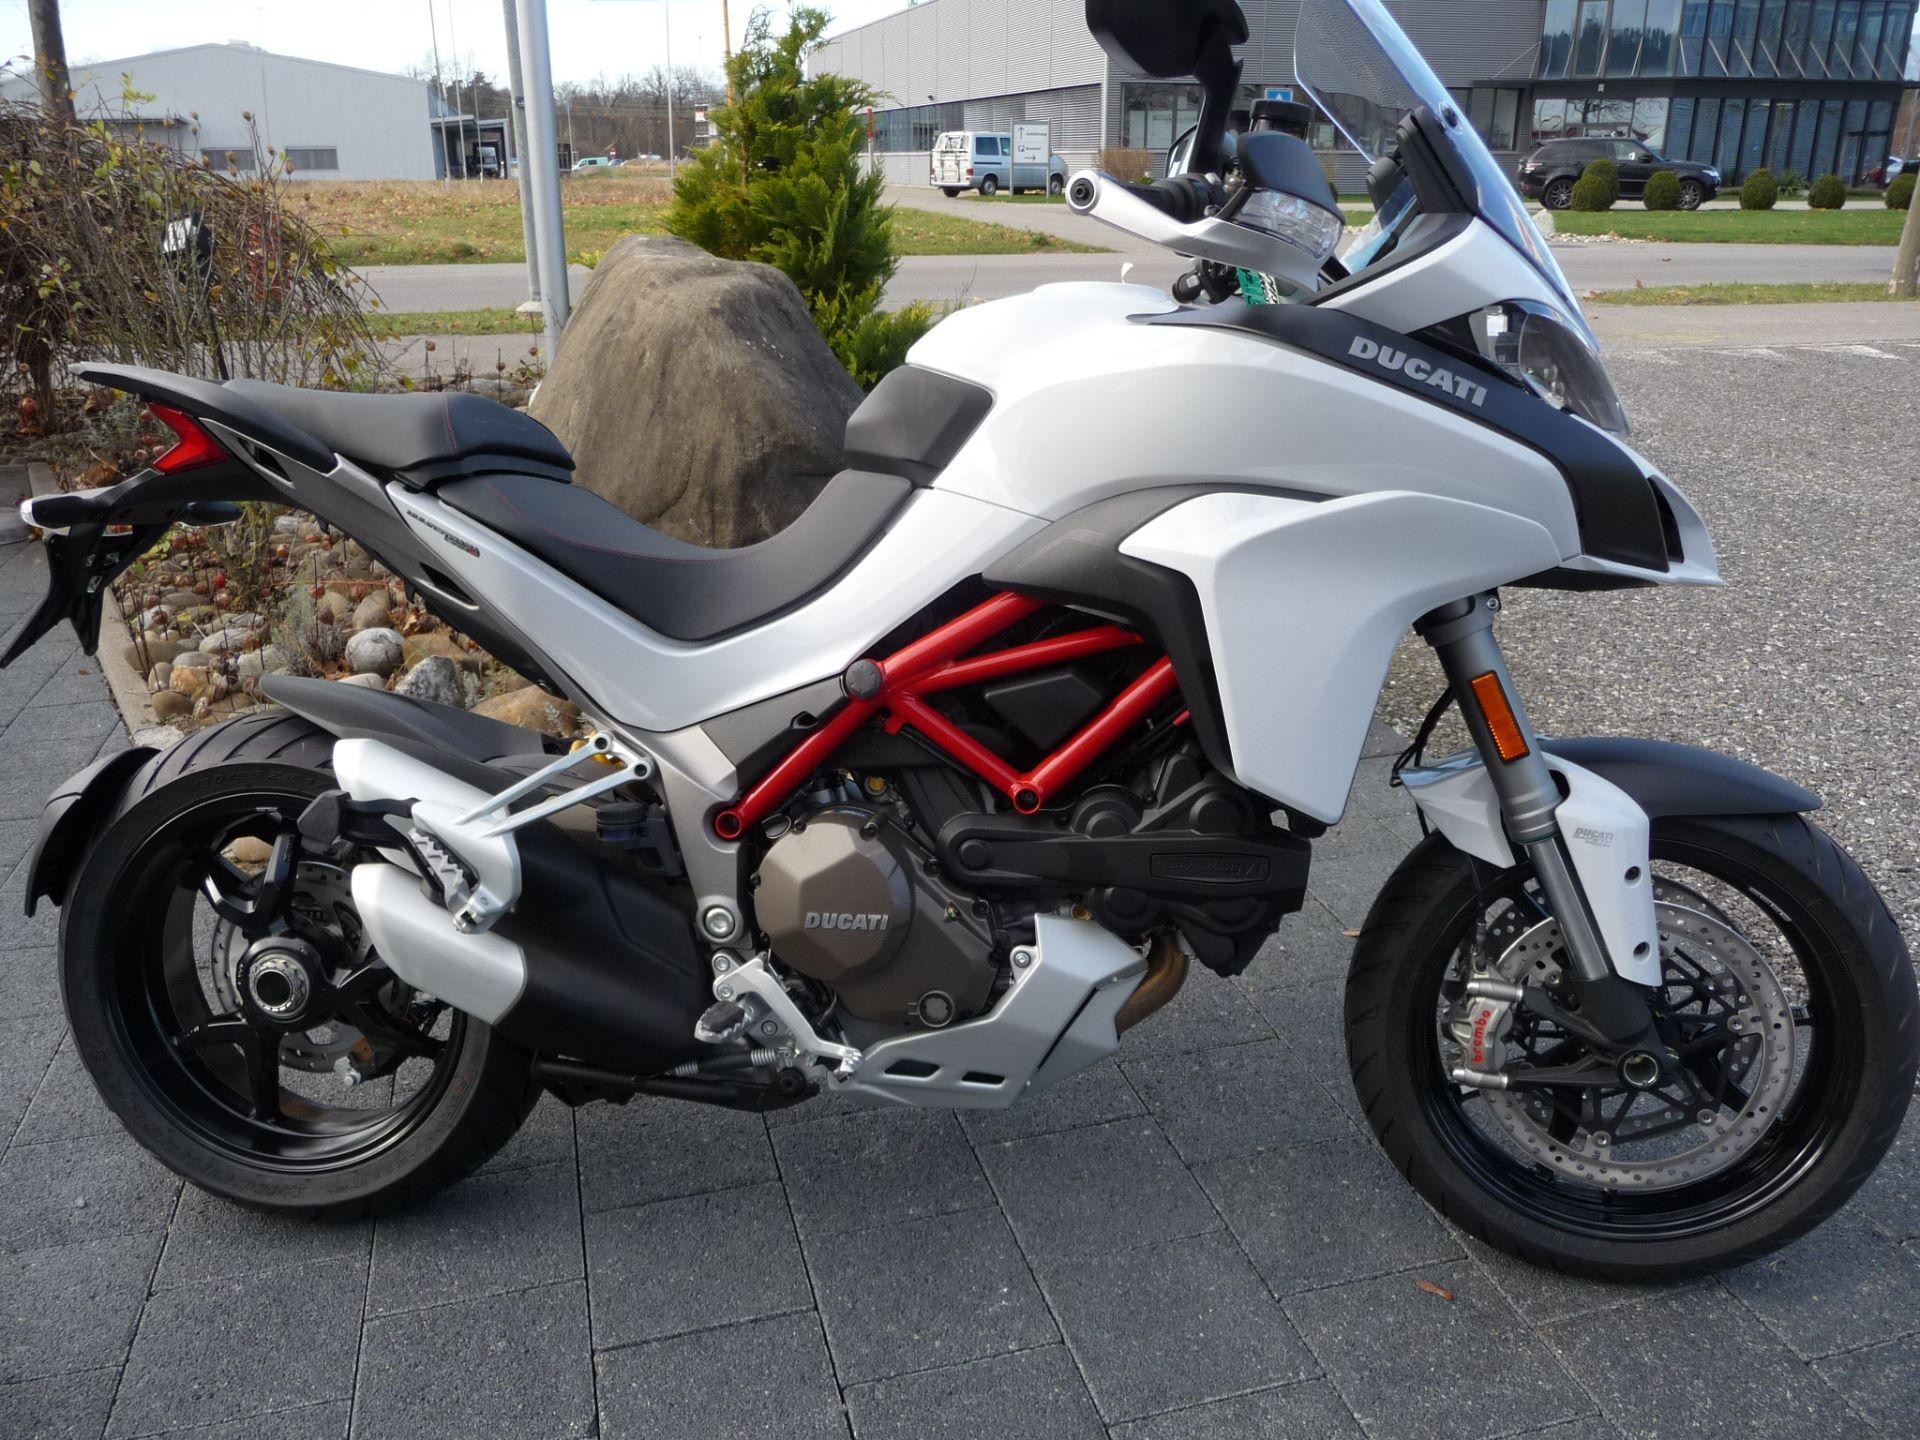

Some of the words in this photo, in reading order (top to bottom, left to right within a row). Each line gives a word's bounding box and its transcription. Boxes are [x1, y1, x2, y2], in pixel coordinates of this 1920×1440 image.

[1348, 335, 1488, 407] DUCATI
[1573, 827, 1615, 841] DUCATI
[804, 911, 889, 931] DUCATI
[1472, 1010, 1491, 1063] brembo
